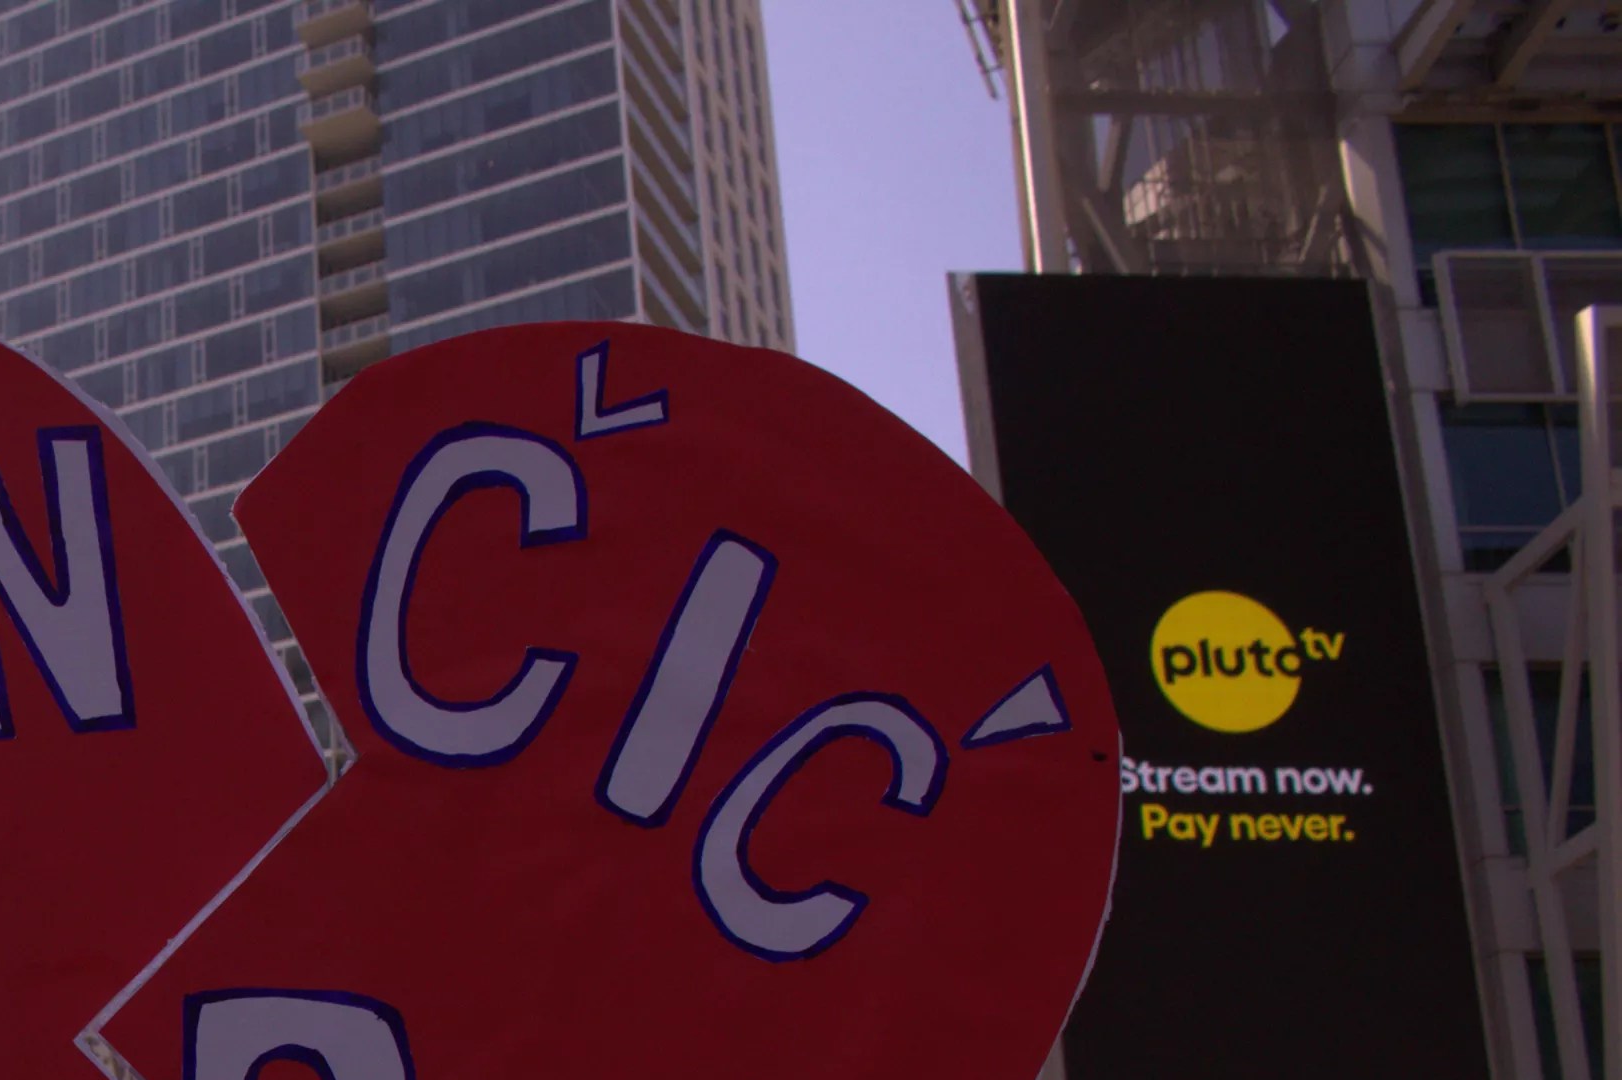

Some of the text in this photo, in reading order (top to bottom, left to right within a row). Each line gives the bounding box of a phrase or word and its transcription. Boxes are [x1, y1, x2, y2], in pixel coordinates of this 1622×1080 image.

[1121, 756, 1374, 796] Stream now.
[1140, 803, 1356, 848] Pay never.
